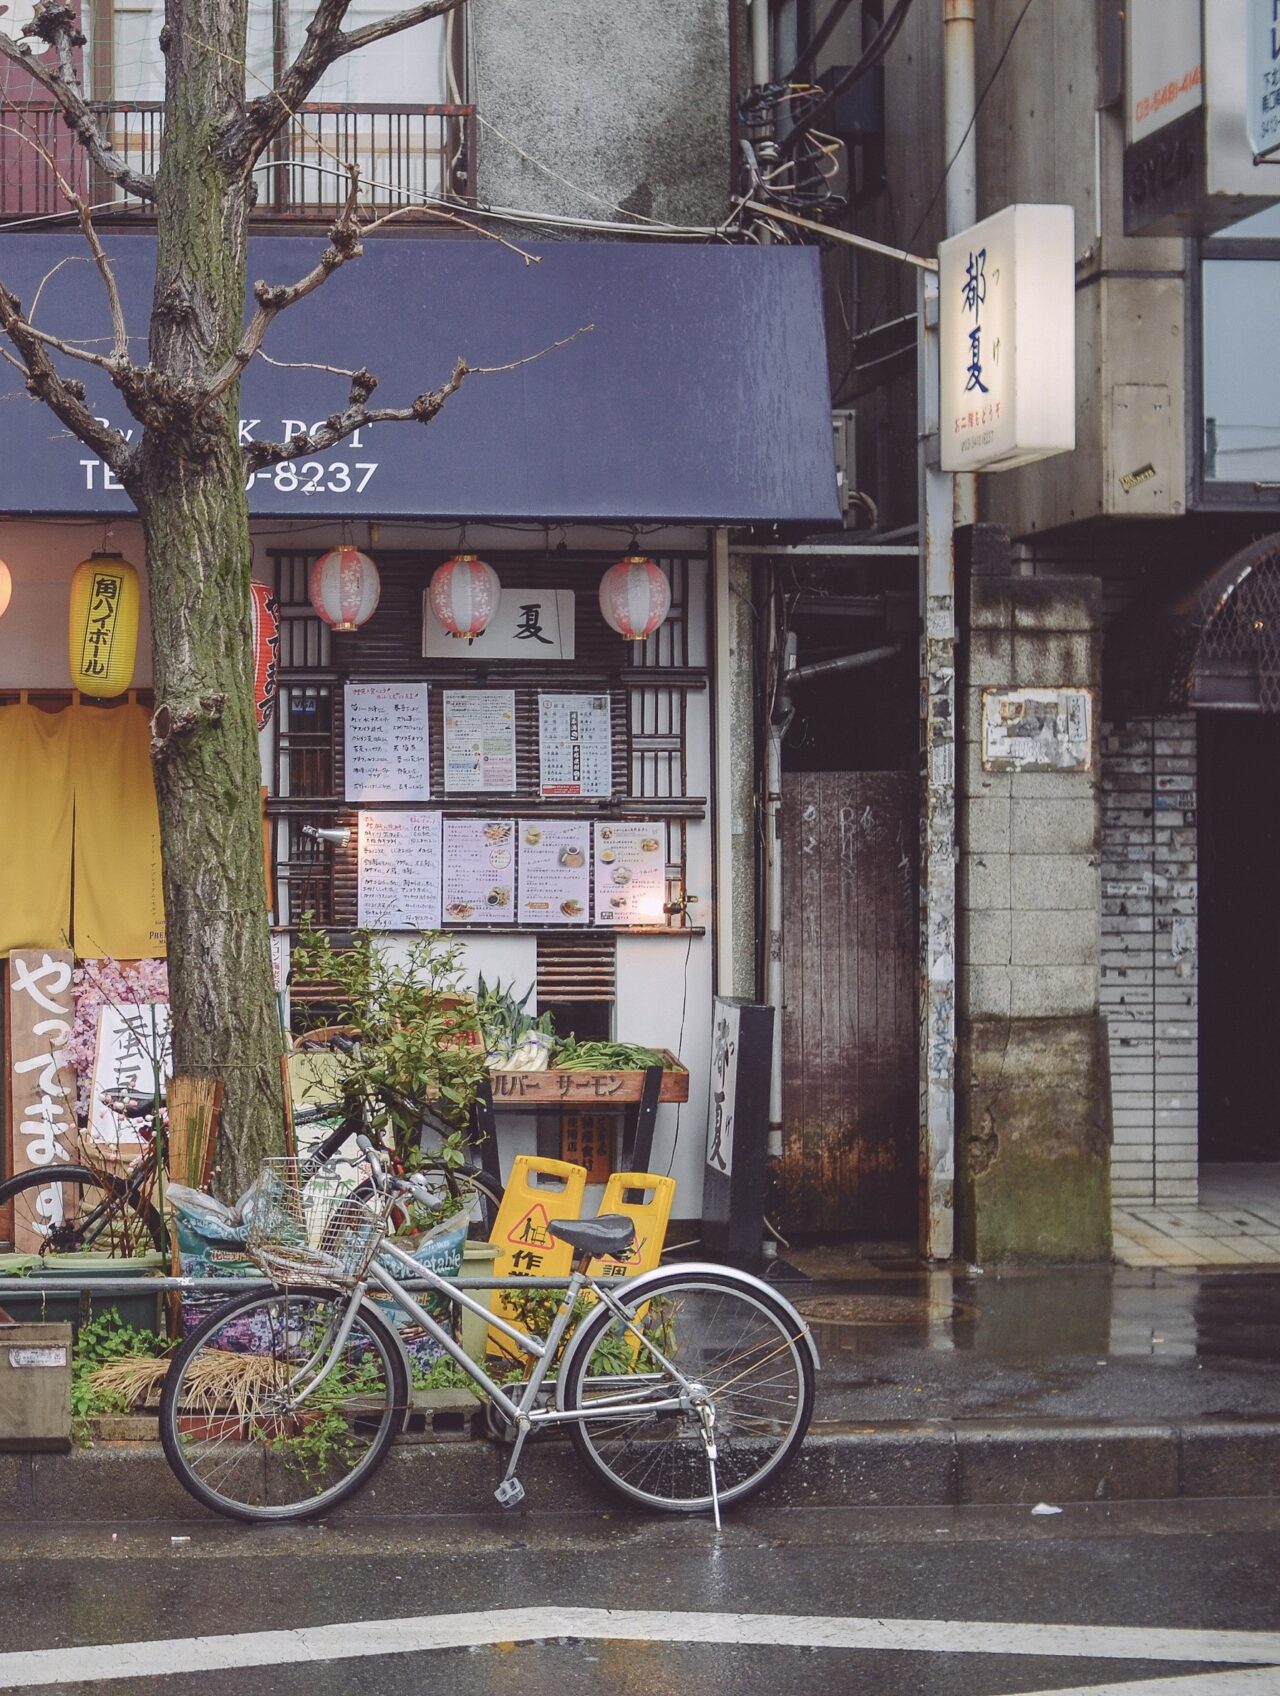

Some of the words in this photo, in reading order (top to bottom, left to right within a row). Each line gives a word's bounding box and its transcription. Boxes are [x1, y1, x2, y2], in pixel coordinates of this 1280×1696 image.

[962, 248, 989, 393] 都夏
[246, 462, 379, 493] -8237
[84, 577, 118, 676] 角ハイボール
[11, 954, 72, 1236] やってます
[556, 1075, 626, 1099] サーモン
